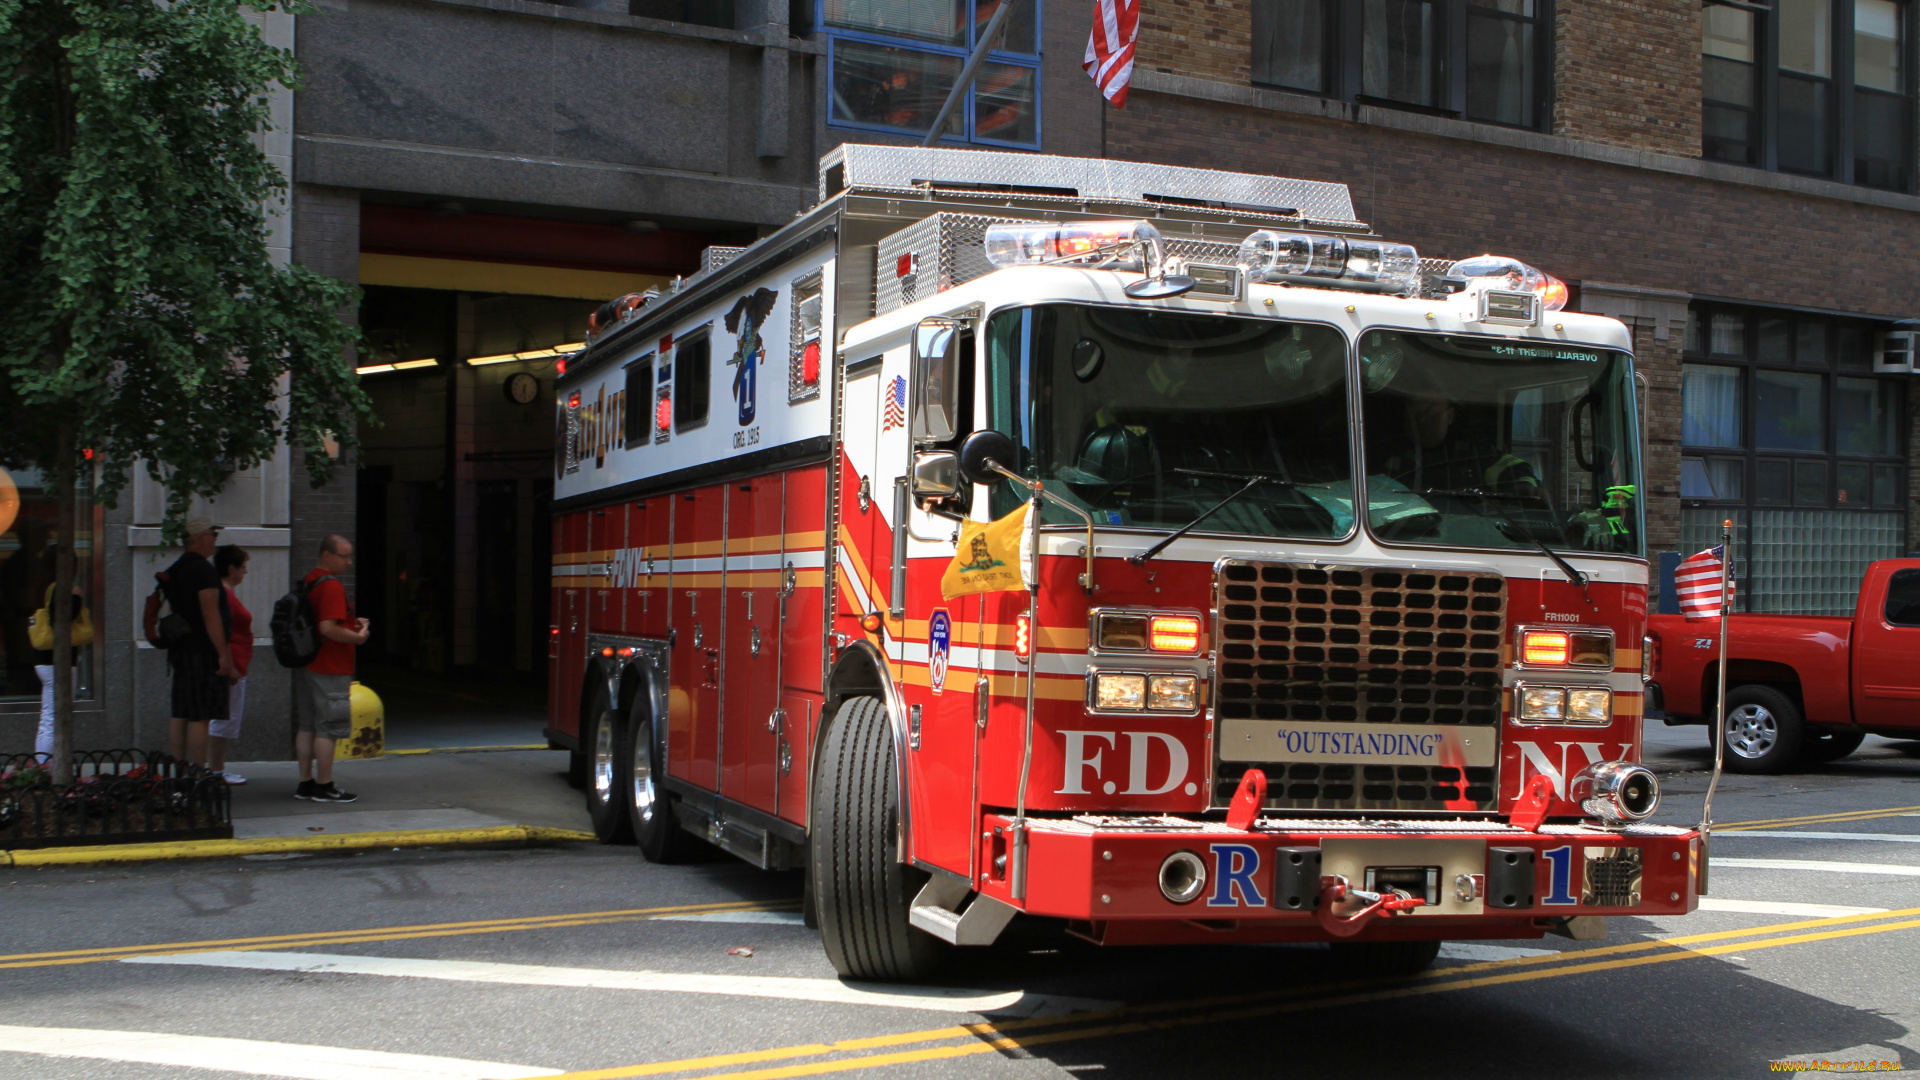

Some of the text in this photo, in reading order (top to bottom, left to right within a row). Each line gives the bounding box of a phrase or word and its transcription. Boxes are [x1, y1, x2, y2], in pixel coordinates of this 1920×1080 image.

[744, 368, 752, 410] 1
[747, 426, 760, 446] 1915
[611, 546, 643, 588] FDNY
[1544, 612, 1580, 623] FR11001
[1053, 729, 1198, 796] F.D.
[1206, 843, 1579, 908] R 1
